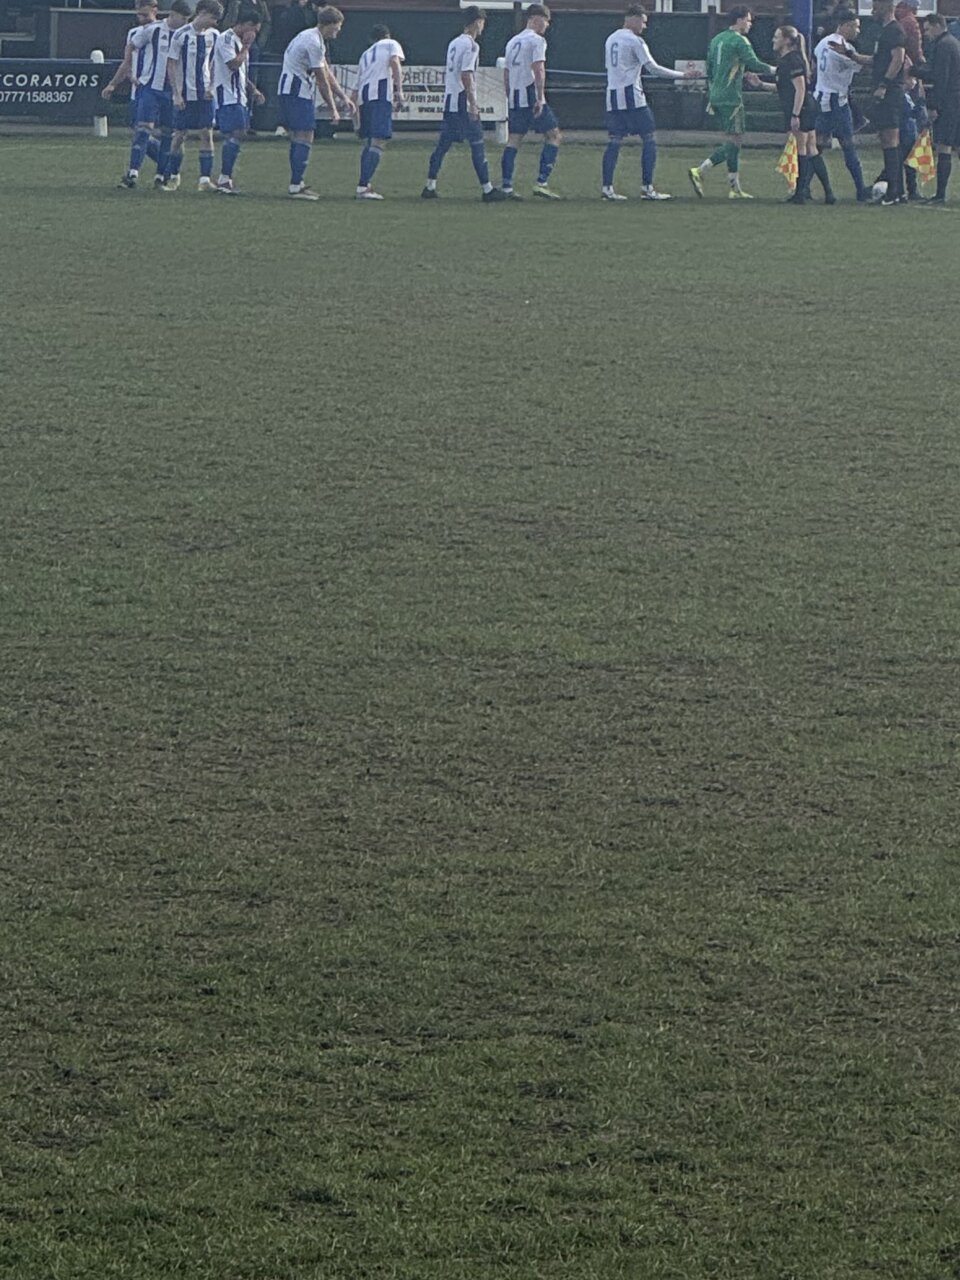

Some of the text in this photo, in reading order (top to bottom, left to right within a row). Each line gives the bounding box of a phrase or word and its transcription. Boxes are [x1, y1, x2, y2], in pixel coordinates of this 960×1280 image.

[512, 41, 522, 66] 2
[611, 42, 619, 67] 6
[0, 74, 99, 87] CORATORS
